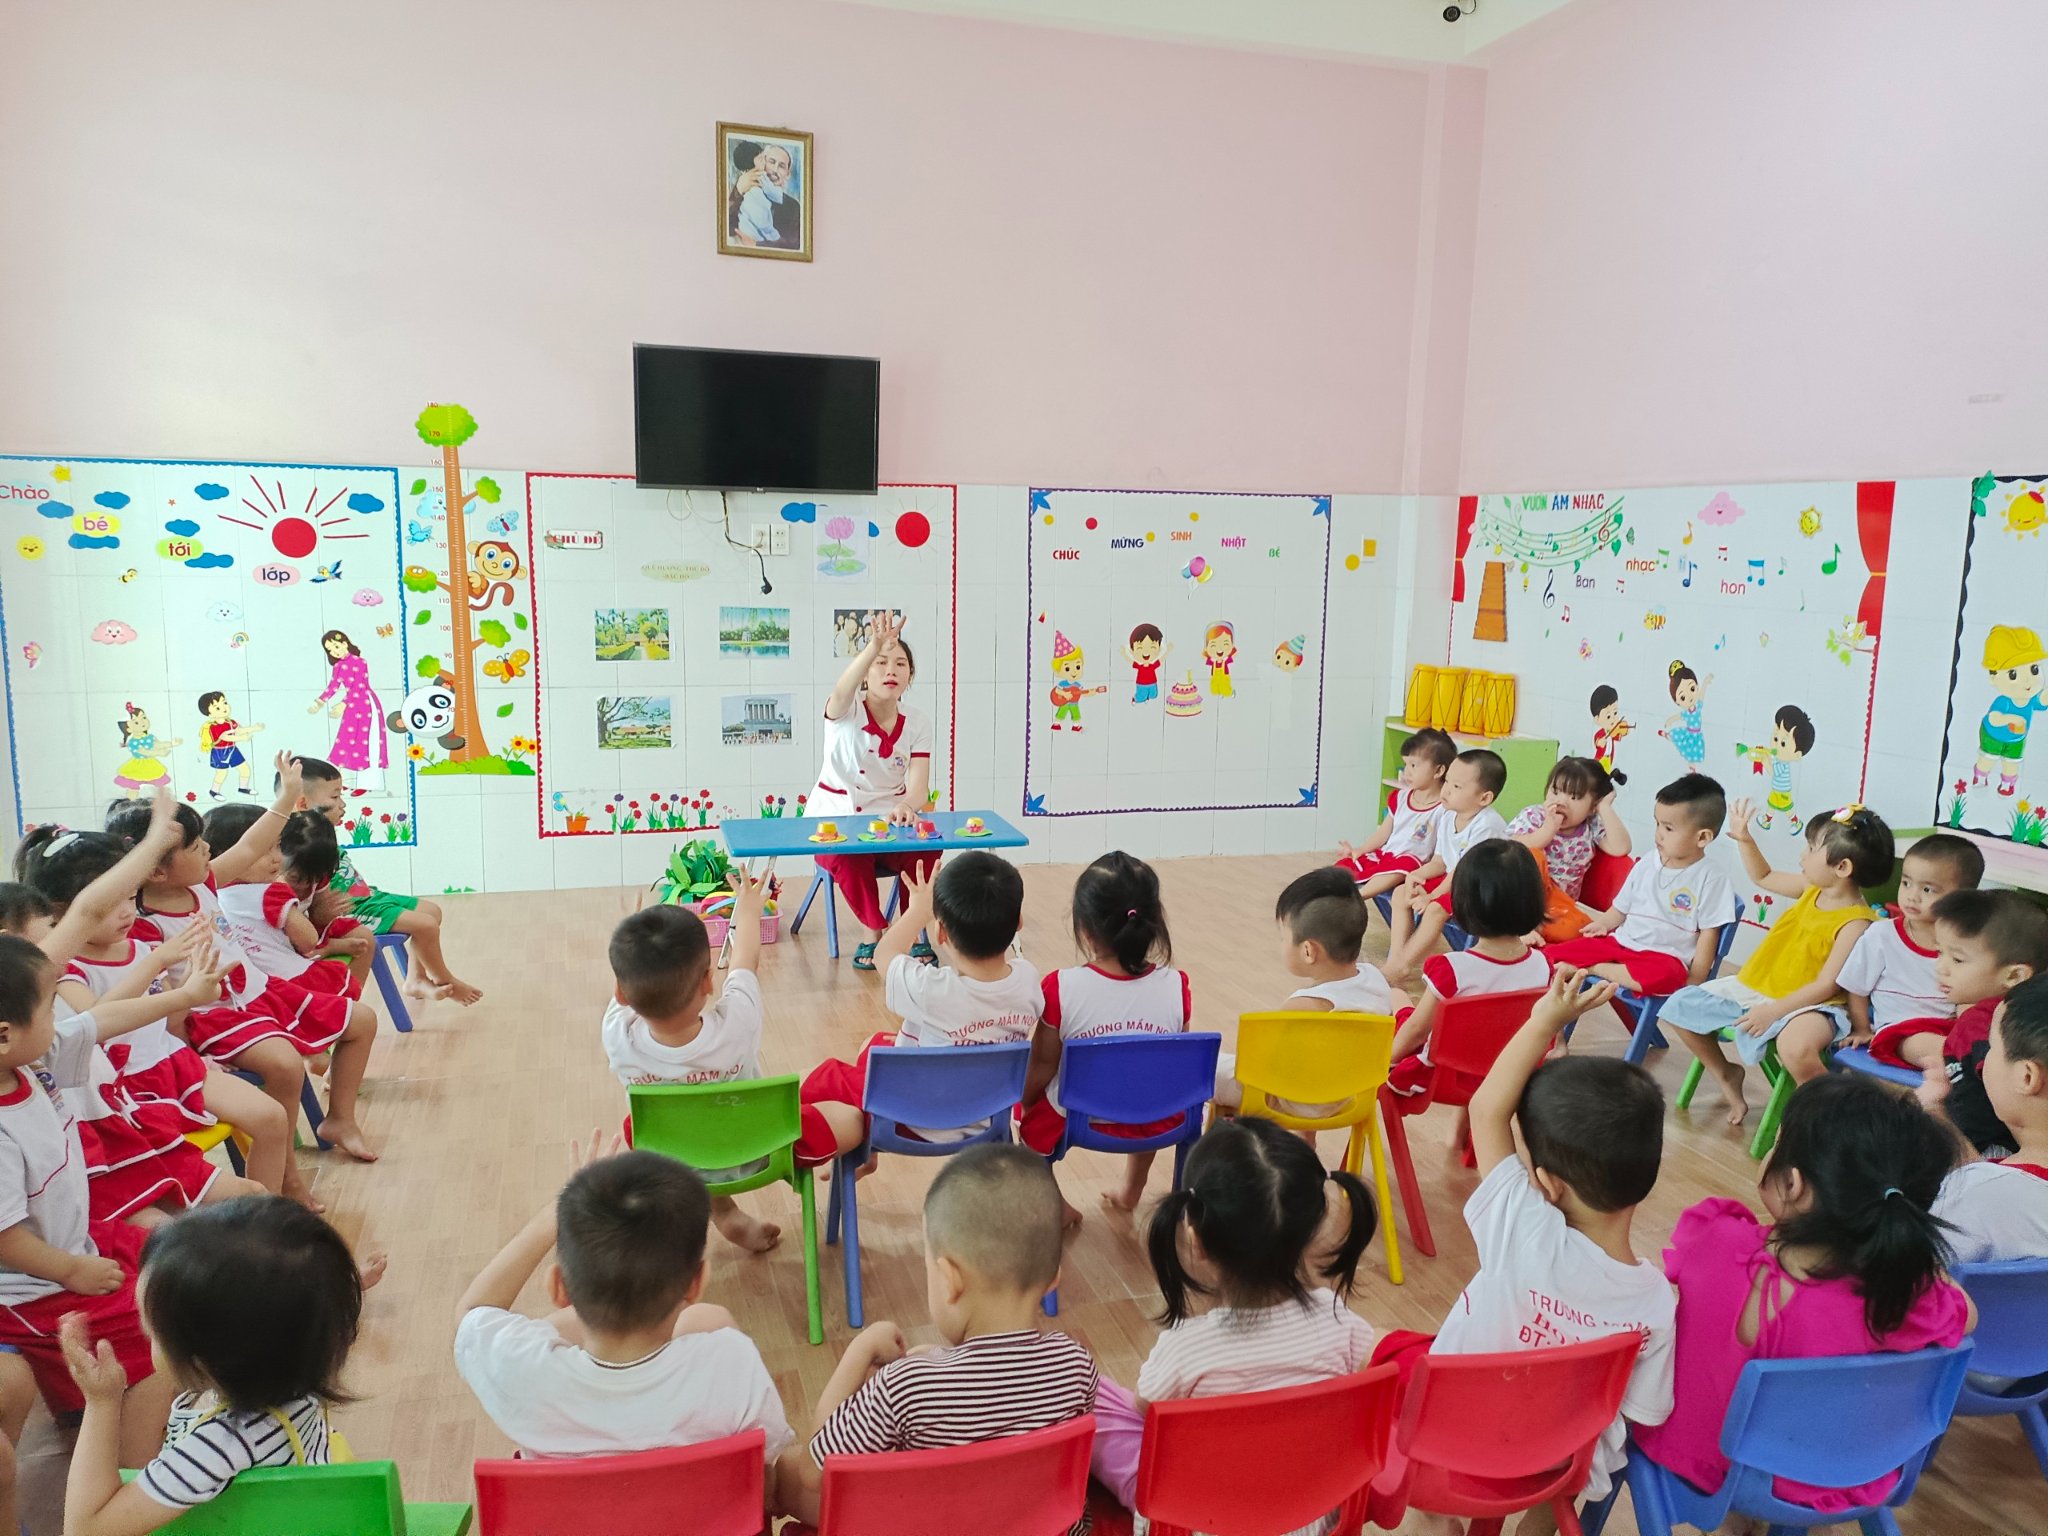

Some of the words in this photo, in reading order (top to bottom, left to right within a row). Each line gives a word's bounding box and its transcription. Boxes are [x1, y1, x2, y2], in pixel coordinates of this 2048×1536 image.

[1572, 493, 1605, 513] NHẠC
[0, 484, 50, 500] Chào
[83, 516, 109, 531] bé
[168, 542, 191, 556] tới
[262, 566, 291, 584] lớp
[1052, 546, 1080, 560] CHÚC
[1110, 536, 1144, 549] MỪNG
[1170, 531, 1192, 541] SINH
[1221, 536, 1247, 550] NHẬT
[1575, 575, 1596, 588] Ban
[1625, 558, 1656, 575] nhạc
[1720, 579, 1746, 595] hon
